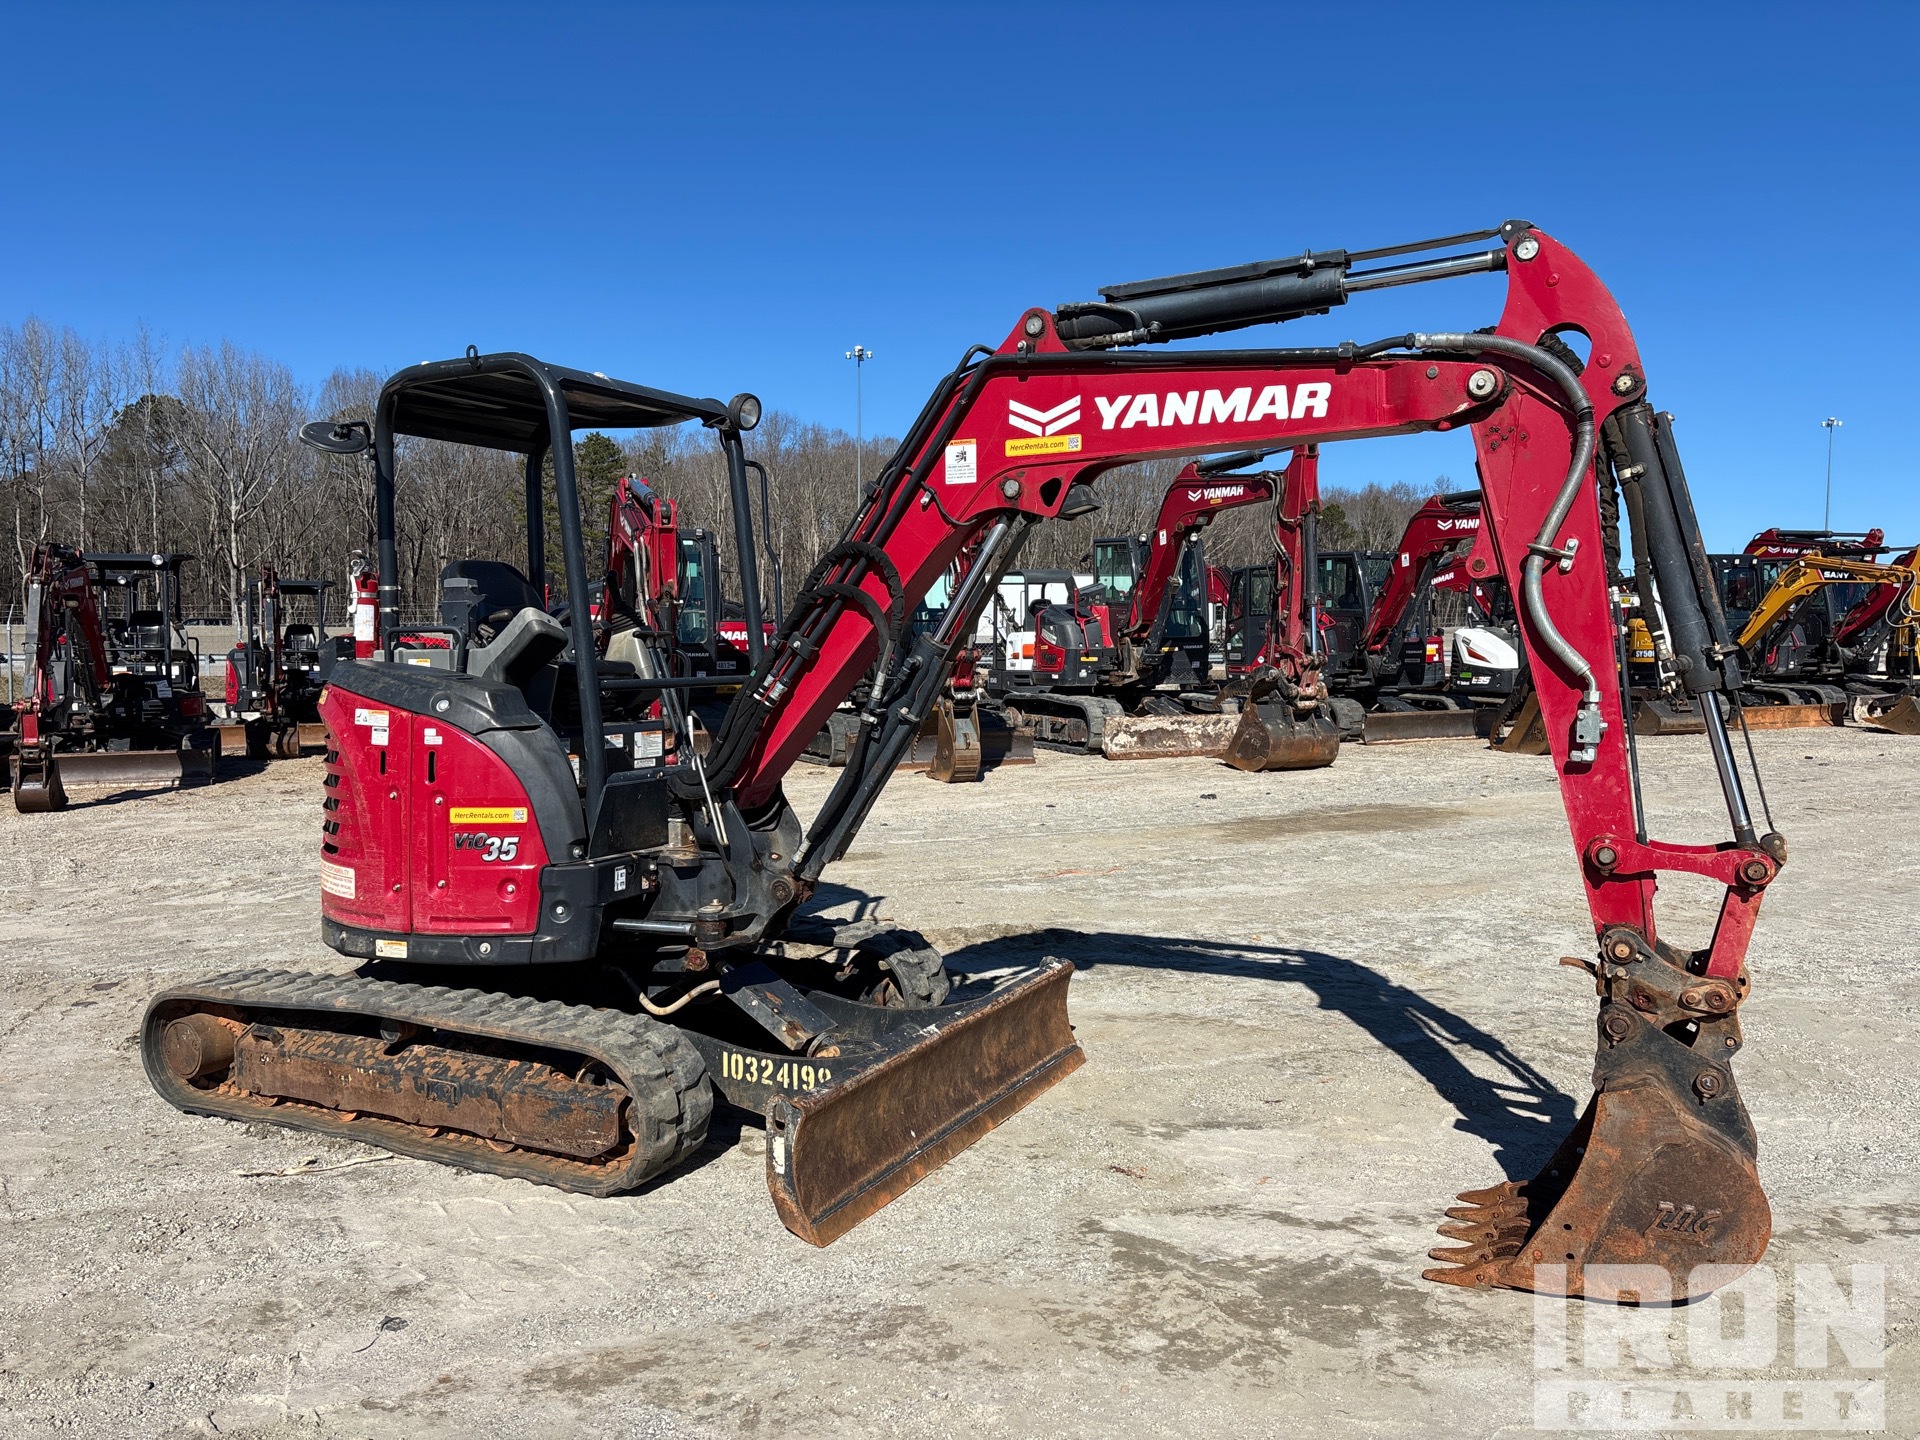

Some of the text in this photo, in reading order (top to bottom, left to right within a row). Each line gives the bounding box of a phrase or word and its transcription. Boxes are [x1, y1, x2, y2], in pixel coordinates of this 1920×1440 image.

[1094, 382, 1332, 430] YANMAR
[1009, 440, 1064, 452] HercRentals.com
[1203, 485, 1244, 500] YANMAR
[1454, 518, 1480, 530] YAN
[1823, 570, 1850, 579] SANY
